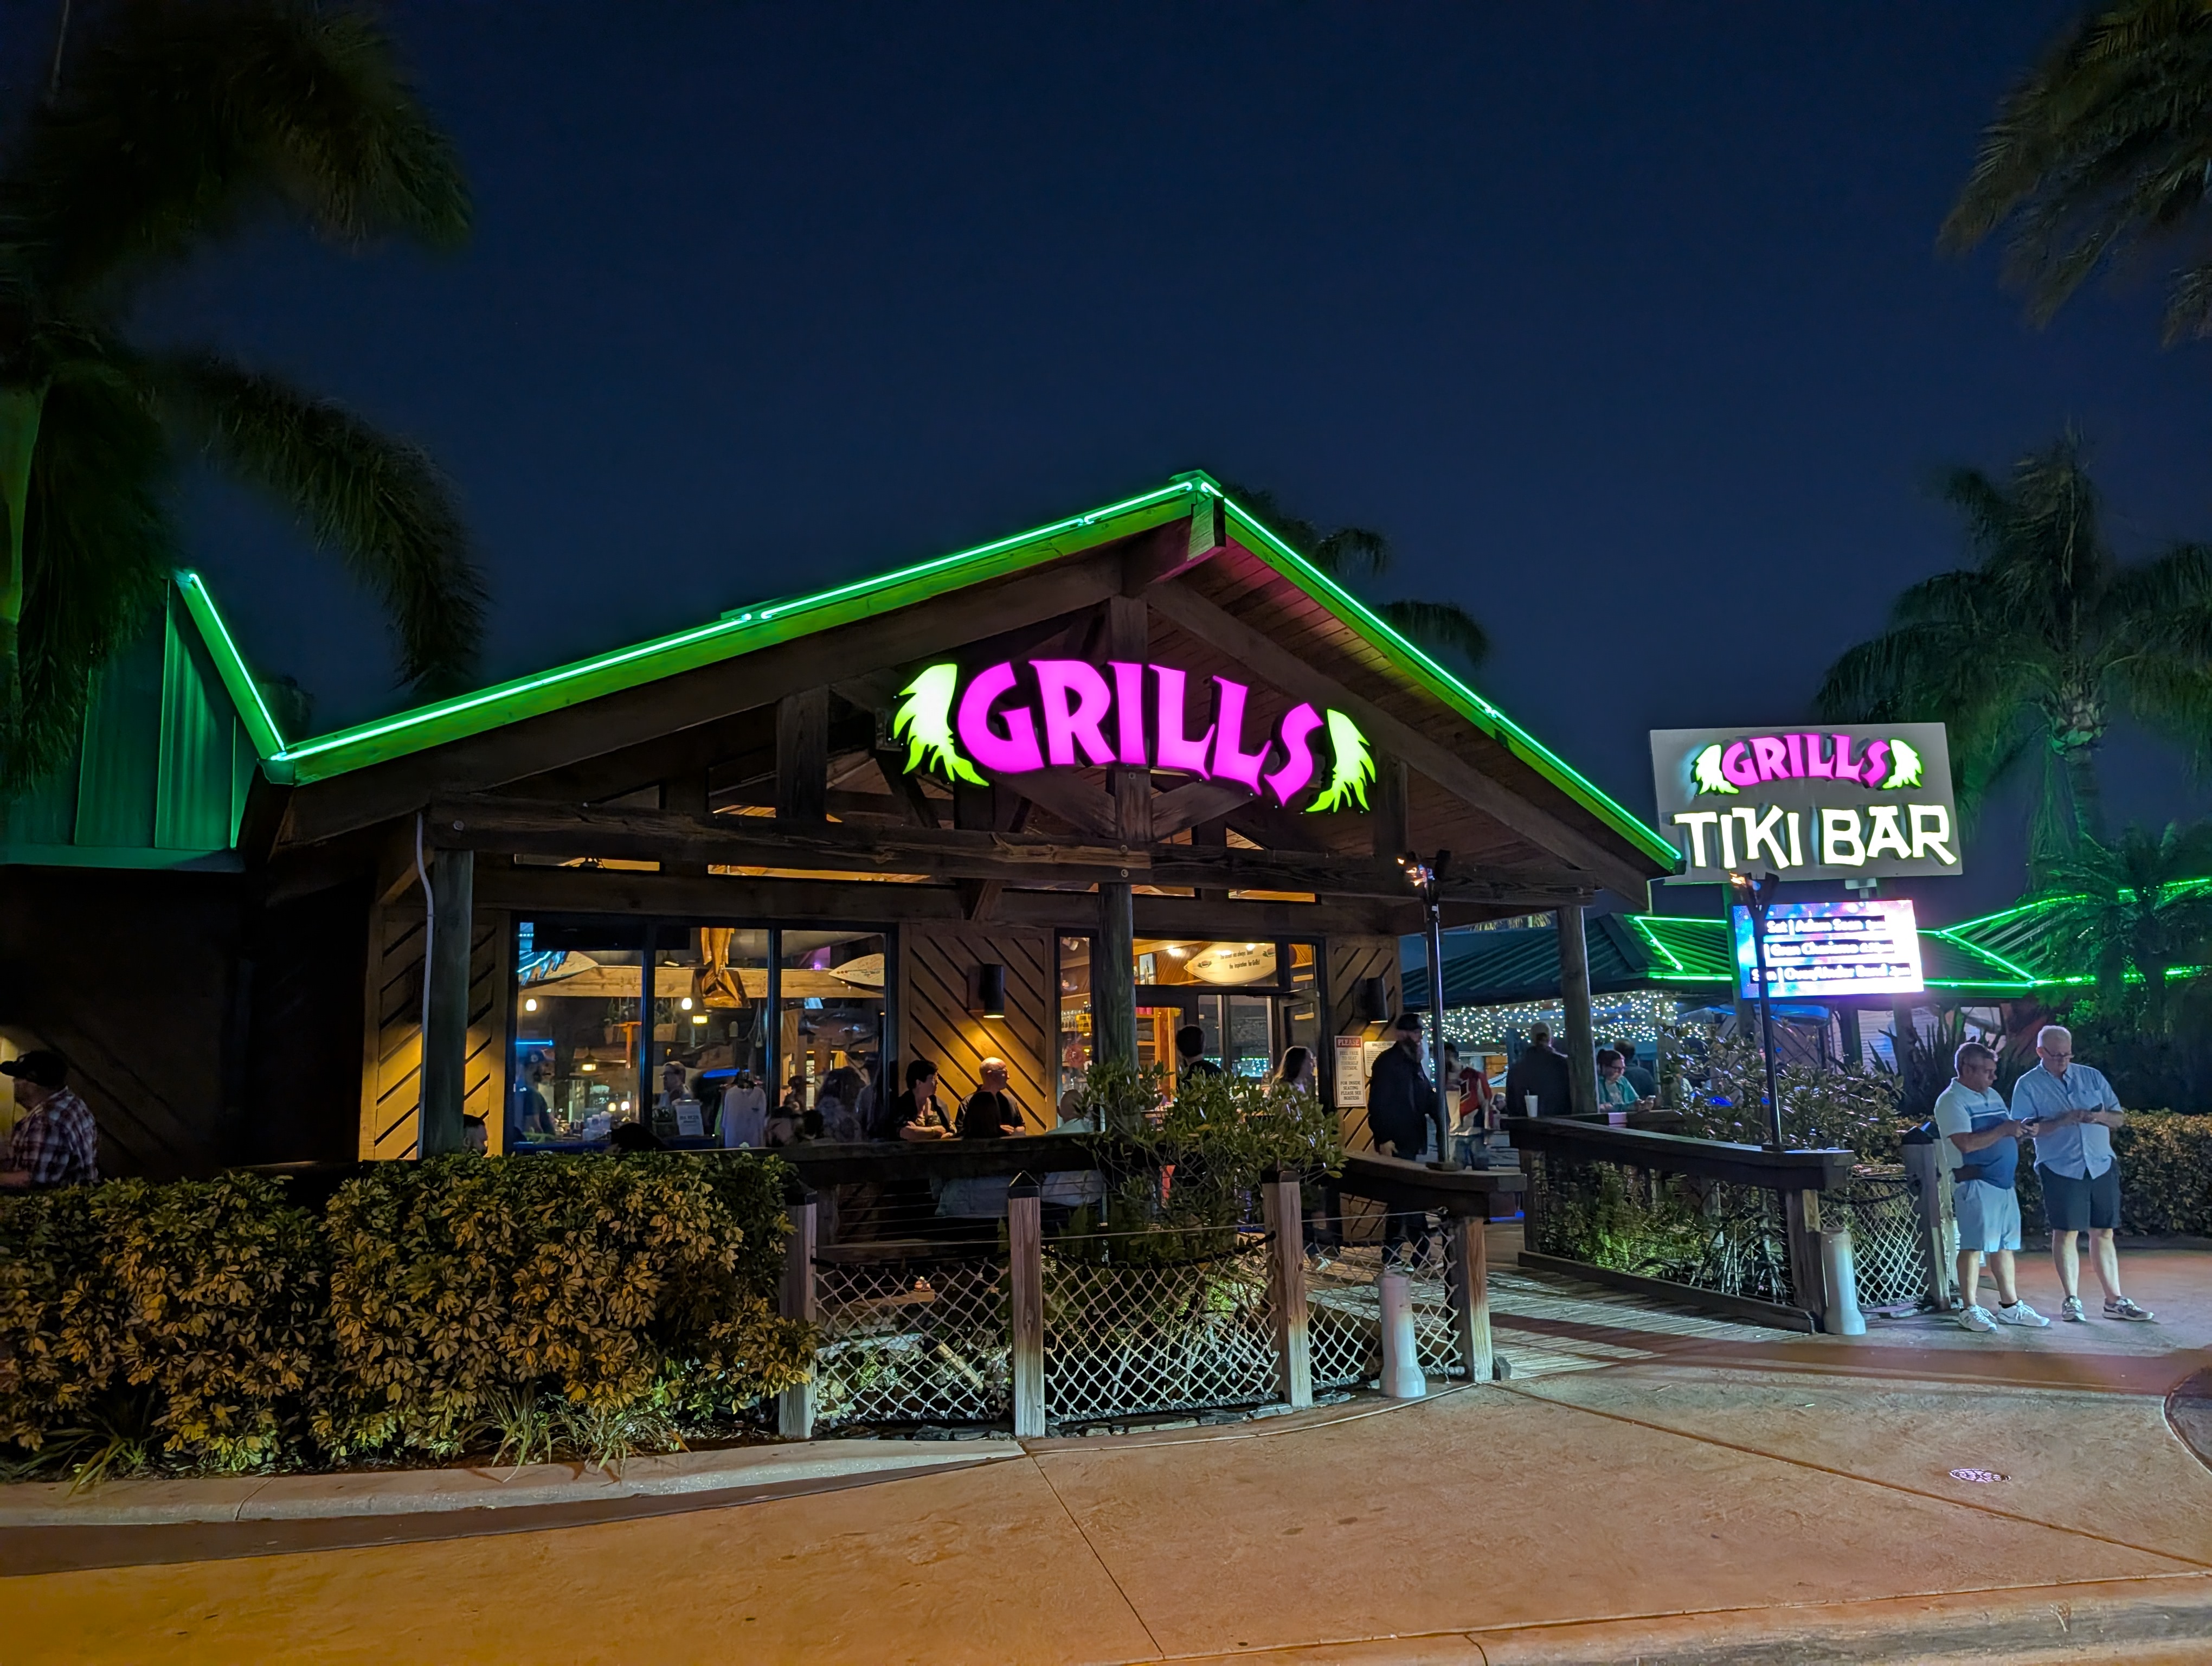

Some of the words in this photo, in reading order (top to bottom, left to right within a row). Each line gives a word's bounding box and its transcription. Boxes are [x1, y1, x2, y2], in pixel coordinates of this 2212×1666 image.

[957, 659, 1323, 808] GRILLS
[1722, 734, 1890, 786] GRILLS
[1674, 805, 1803, 869] TIKI
[1821, 805, 1957, 867] BAR
[1752, 969, 1777, 981] Sn
